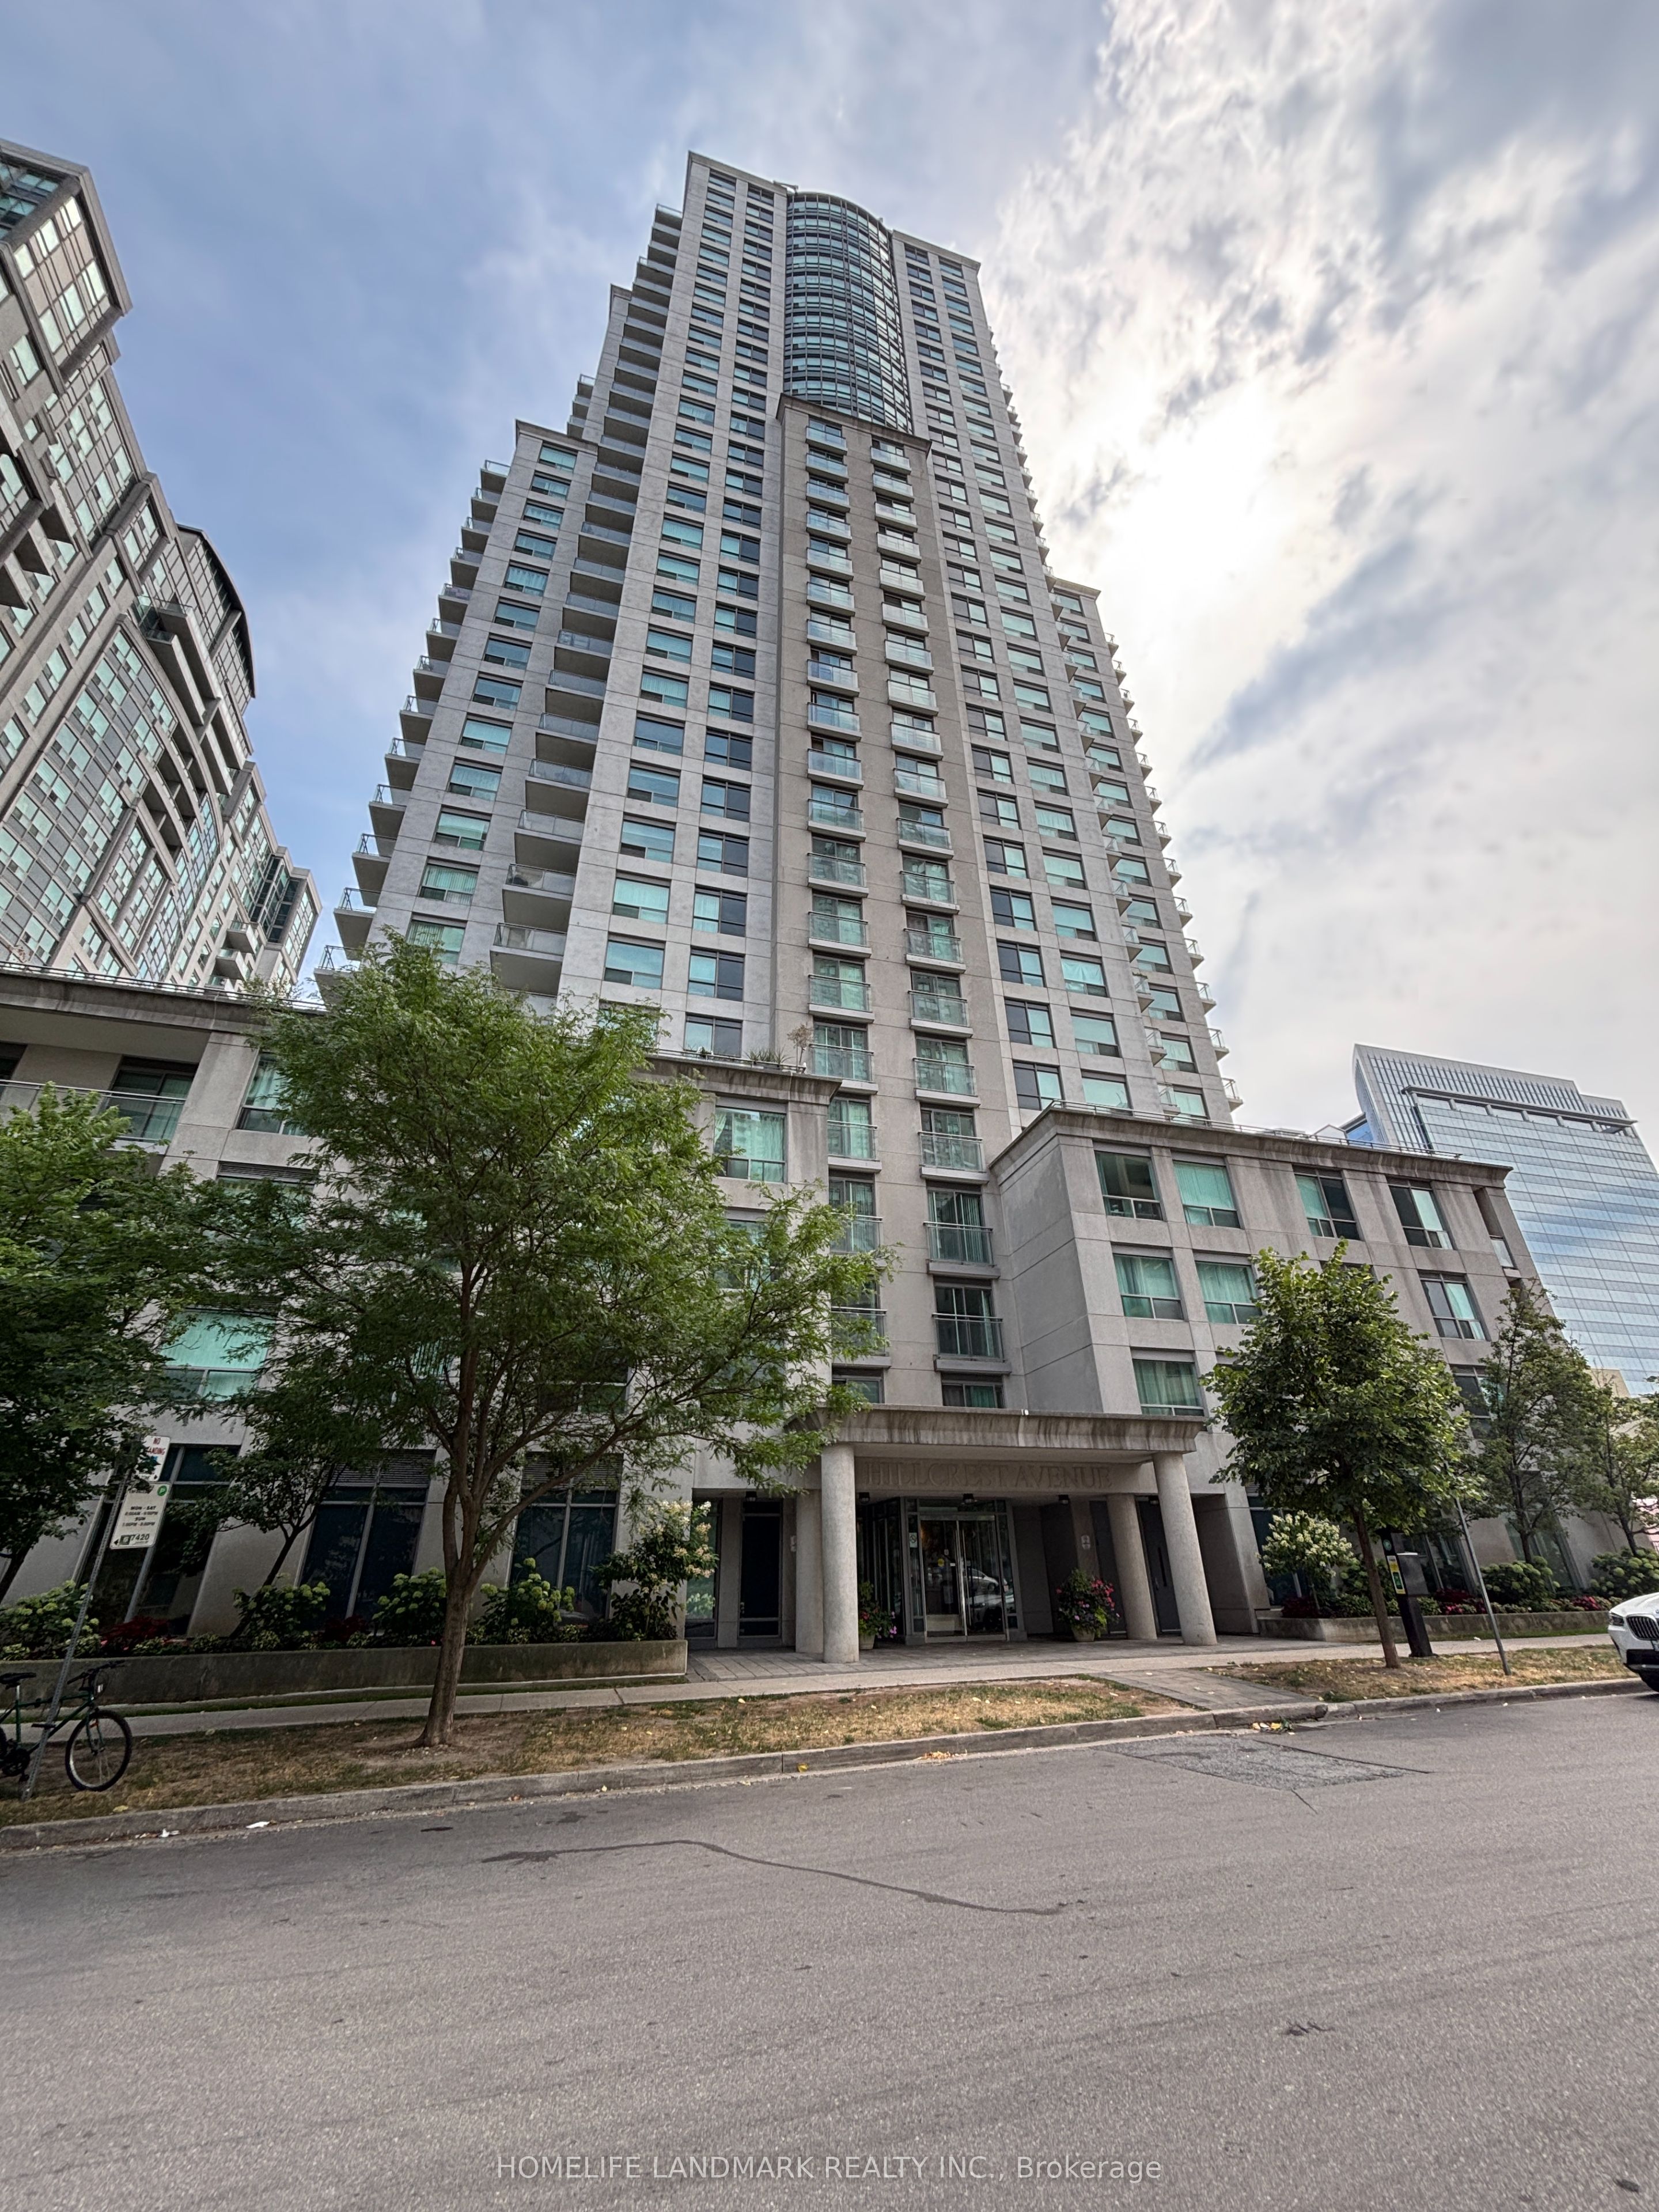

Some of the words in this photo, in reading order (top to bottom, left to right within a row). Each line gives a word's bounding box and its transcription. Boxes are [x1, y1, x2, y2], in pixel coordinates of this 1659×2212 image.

[865, 1461, 1009, 1488] HILLCREST
[1014, 1464, 1112, 1489] AVENUE
[131, 1533, 150, 1541] 7420
